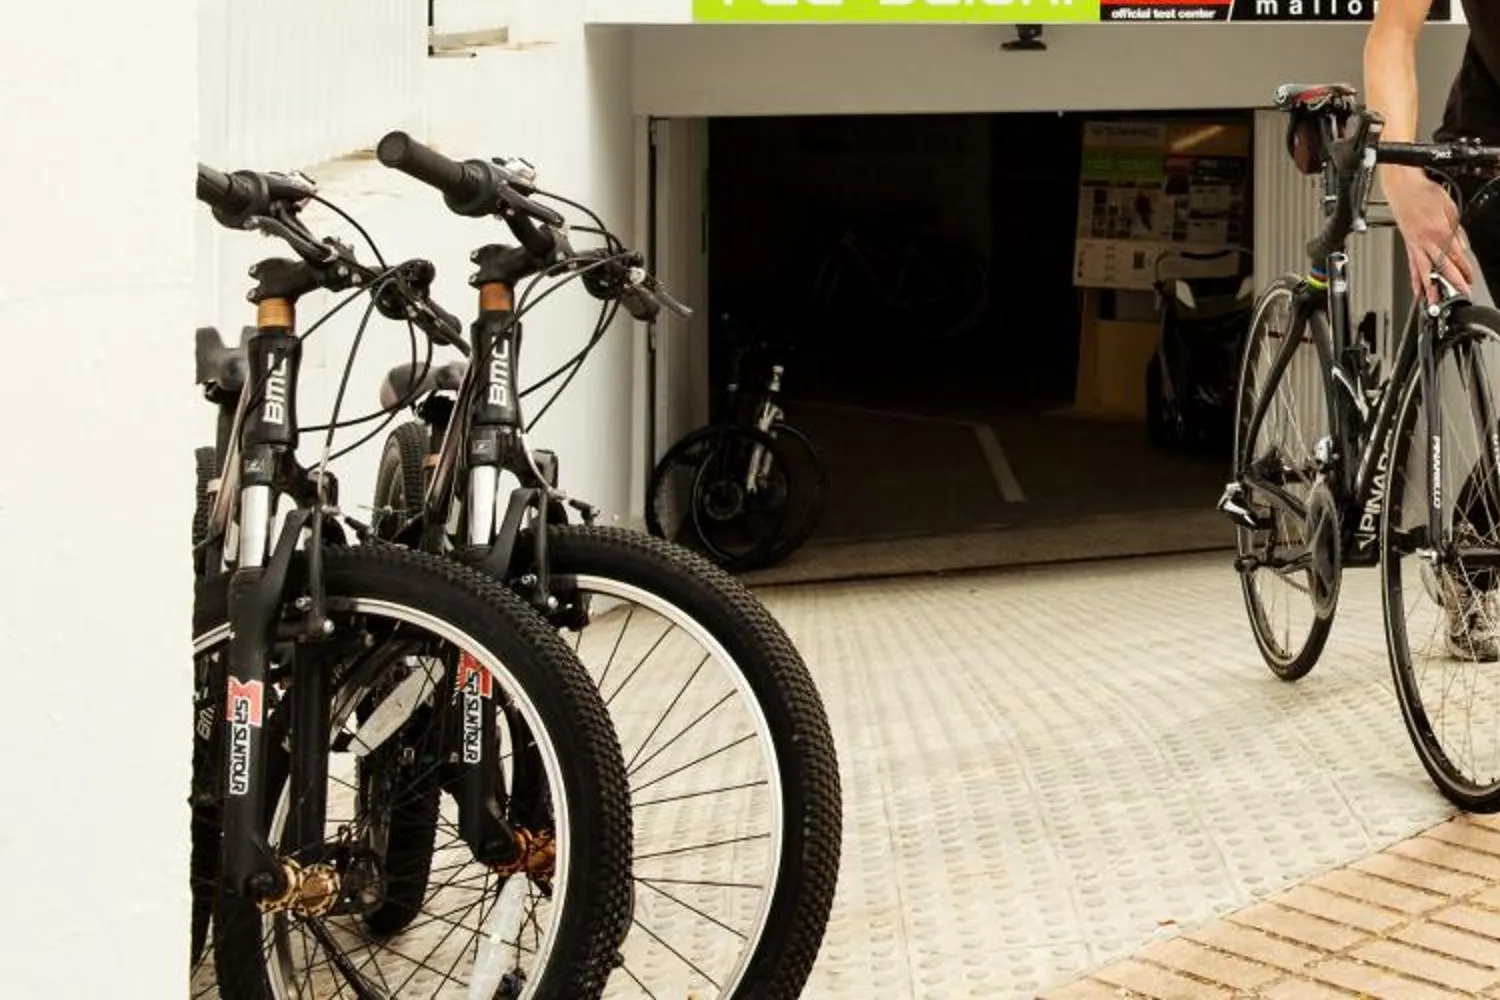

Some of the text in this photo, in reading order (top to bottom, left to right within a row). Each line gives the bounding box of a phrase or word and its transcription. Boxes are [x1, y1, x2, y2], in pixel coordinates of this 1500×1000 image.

[1111, 7, 1216, 19] official test center
[231, 726, 248, 793] SUNTOUR
